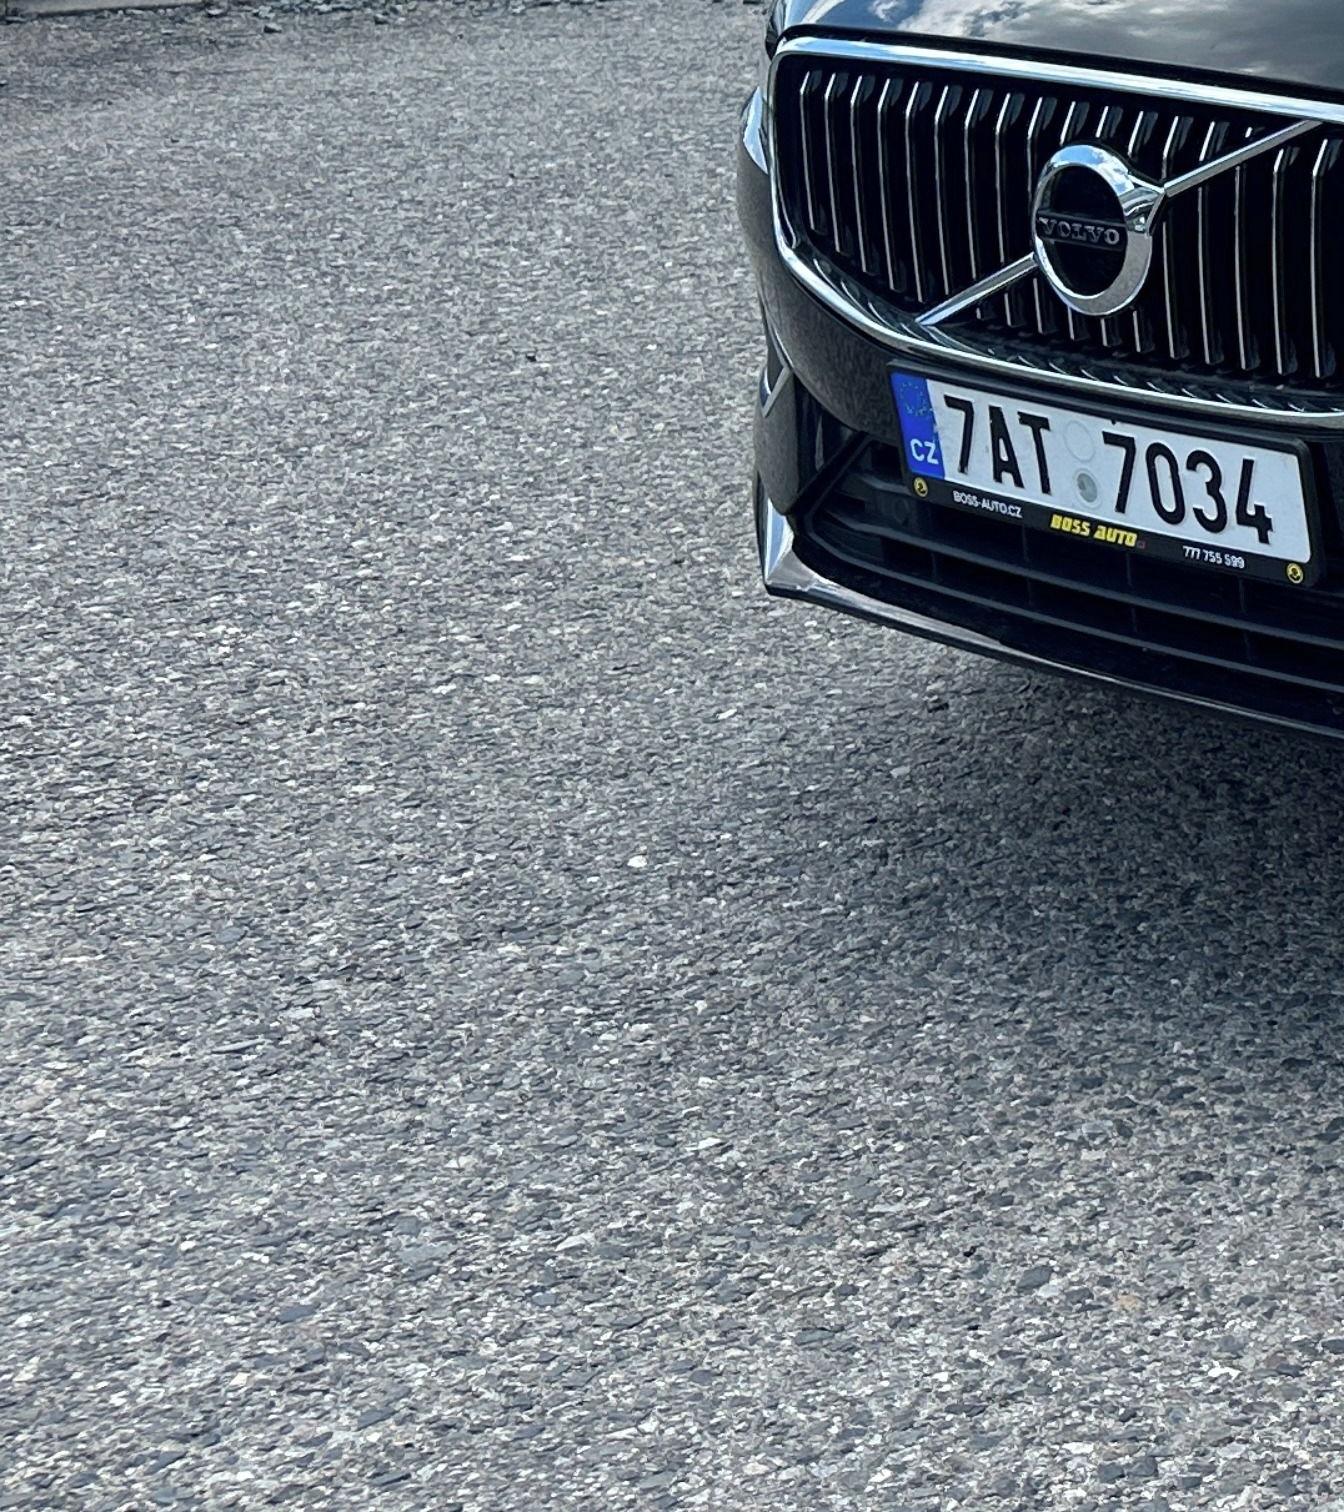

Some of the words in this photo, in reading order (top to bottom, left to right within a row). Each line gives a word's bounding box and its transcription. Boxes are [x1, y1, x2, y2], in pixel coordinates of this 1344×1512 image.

[1037, 216, 1120, 246] VOLVO
[909, 438, 940, 465] CZ
[944, 394, 1052, 496] 7AT
[1102, 430, 1274, 545] 7034
[953, 491, 1023, 519] BOSS-AUTO.CZ
[1051, 514, 1091, 536] BOSS
[1094, 526, 1138, 548] AUTO
[1183, 545, 1201, 559] 777
[1202, 548, 1223, 565] 755
[1224, 554, 1245, 569] 599
